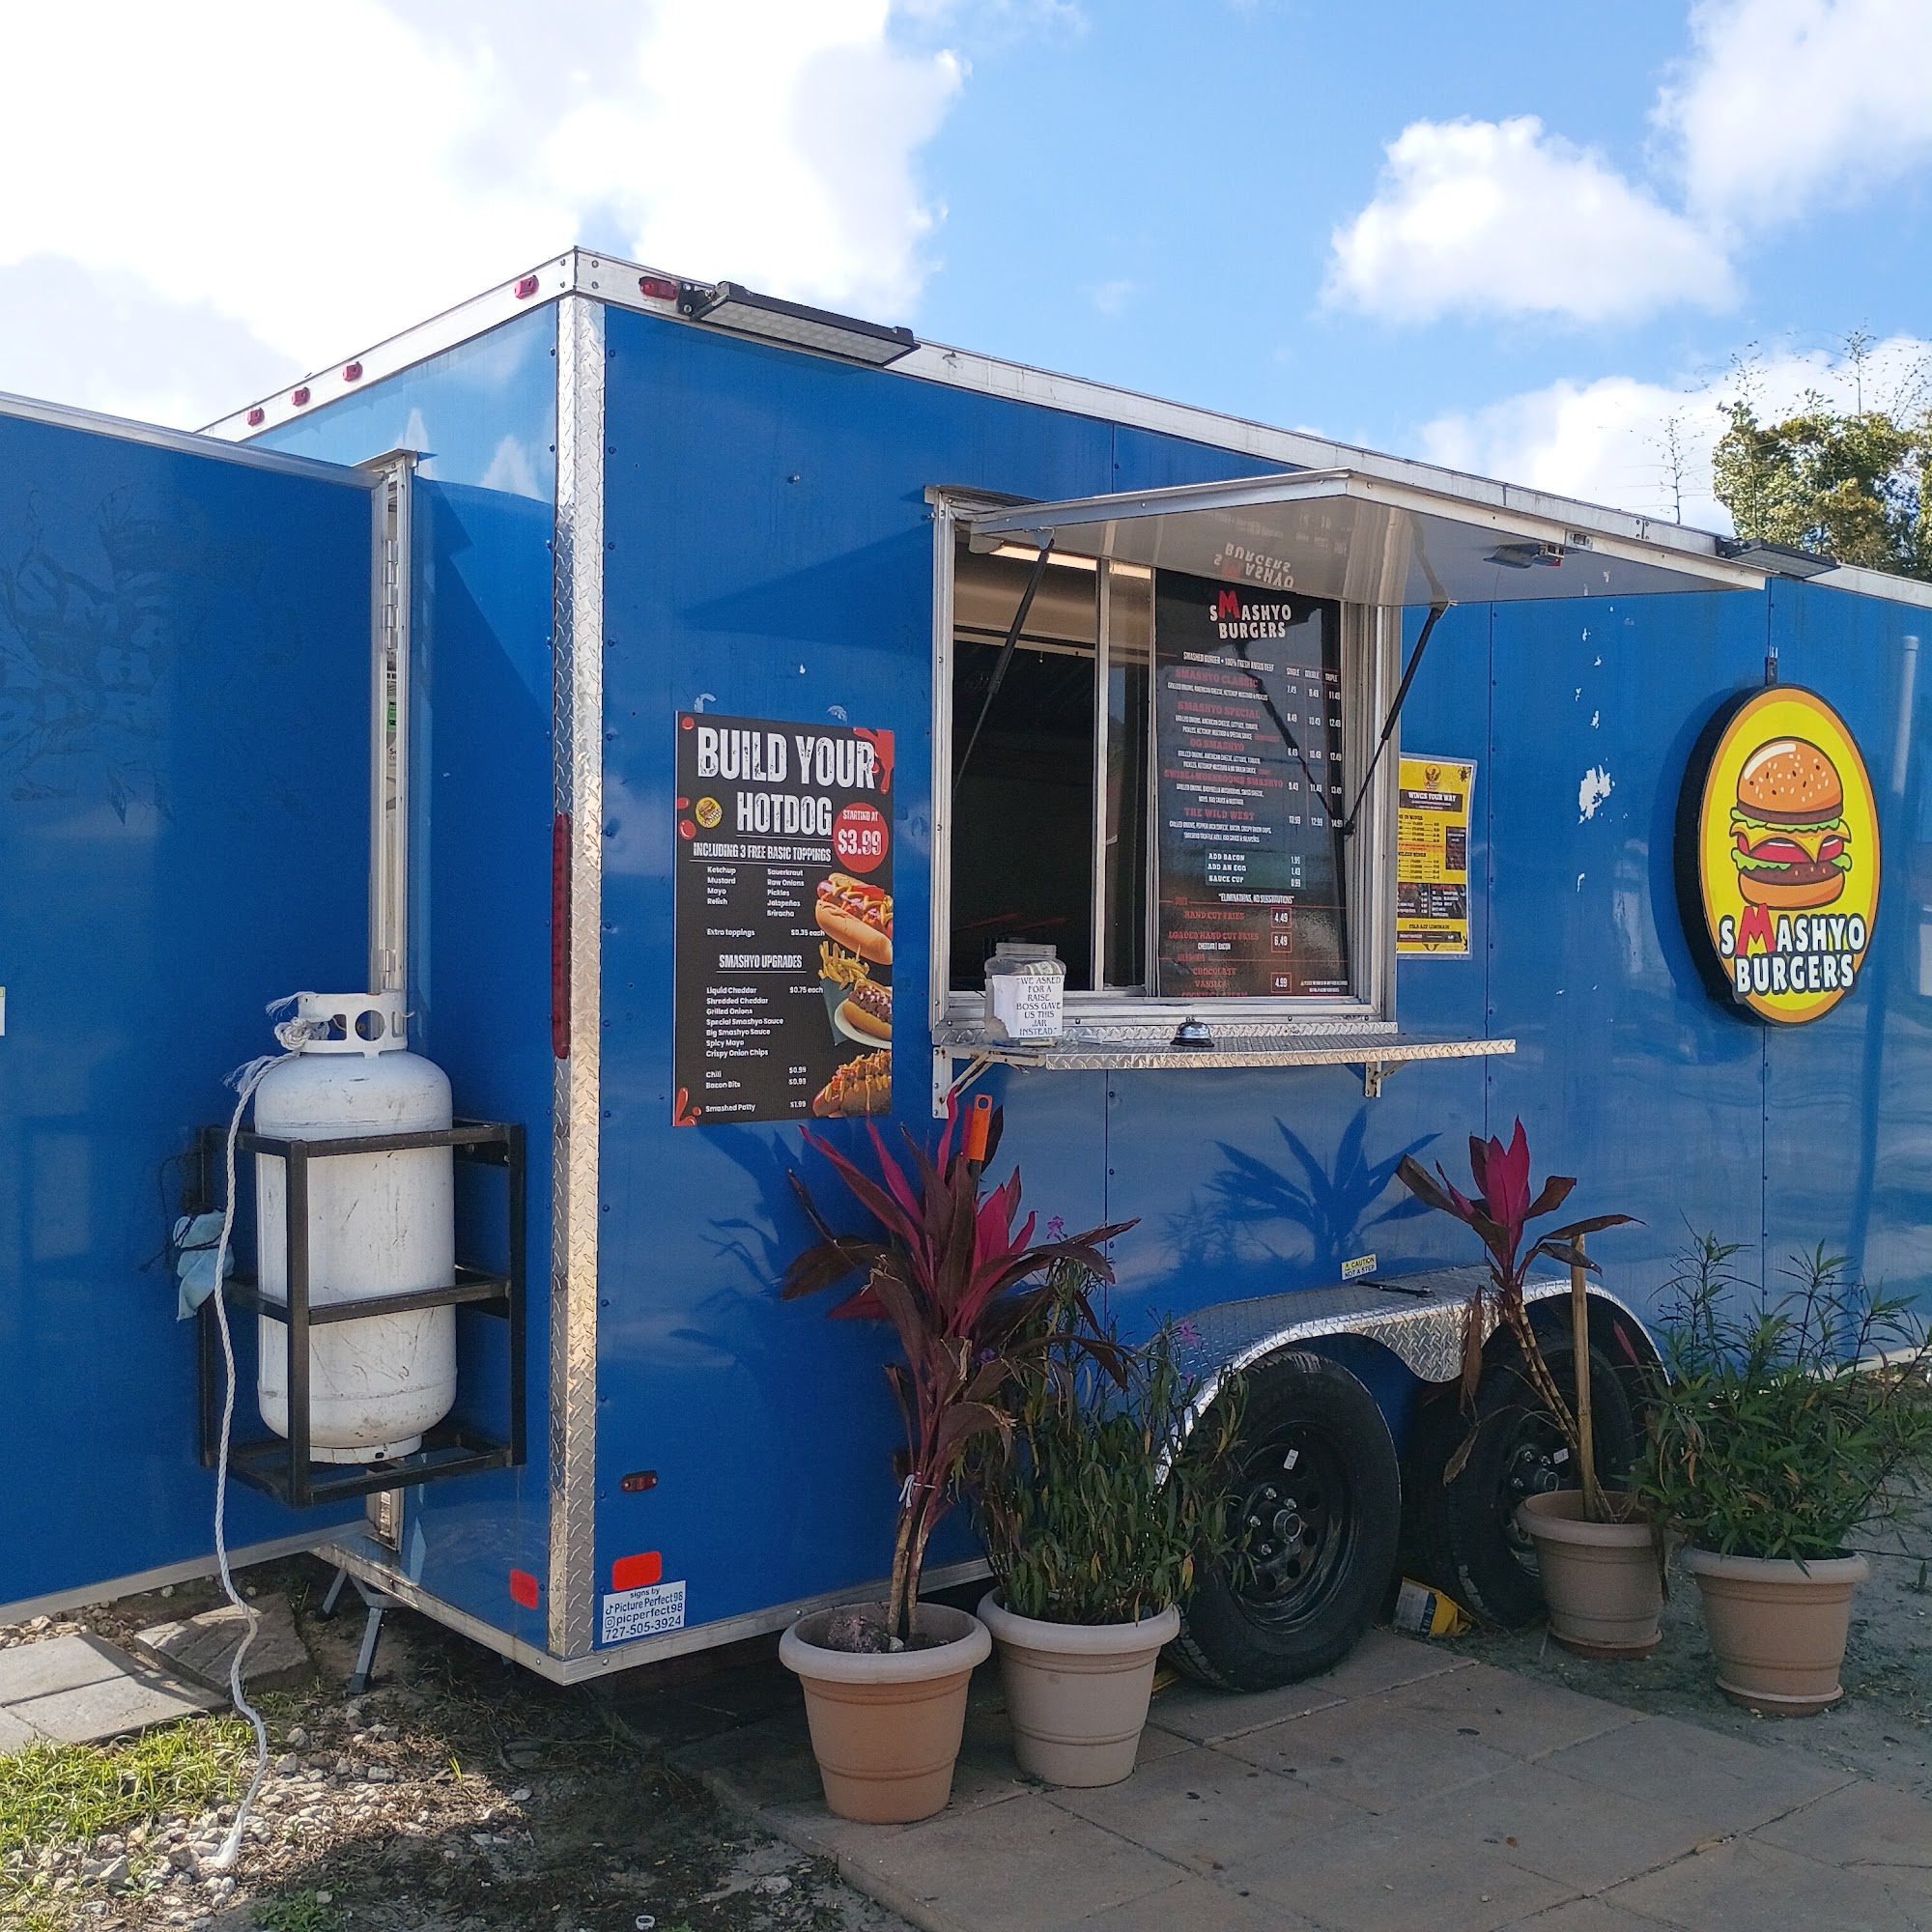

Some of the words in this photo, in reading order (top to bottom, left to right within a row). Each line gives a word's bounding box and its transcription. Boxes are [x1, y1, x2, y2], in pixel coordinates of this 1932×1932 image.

[1209, 589, 1292, 622] SMASHYO
[1219, 622, 1286, 639] BURGERS
[1175, 668, 1220, 682] SMASHYO
[1221, 674, 1258, 689] CLASSIC
[1178, 701, 1222, 714] SMASHYO
[1224, 706, 1260, 719] SPECIAL
[1204, 739, 1244, 752] SMASHYO
[697, 726, 787, 782] BUILD
[795, 736, 875, 789] YOUR
[736, 791, 833, 836] HOTDOG
[842, 809, 870, 821] STARTING
[871, 810, 879, 822] AT
[1184, 807, 1202, 817] THE
[1205, 809, 1227, 819] WILD
[1229, 810, 1254, 821] WEST
[838, 829, 881, 856] $3.99
[693, 842, 739, 858] INCLUDING
[740, 845, 746, 858] 3
[747, 845, 766, 859] FREE
[767, 846, 792, 861] BASIC
[792, 847, 832, 863] TOPPINGS
[1223, 853, 1245, 861] BACON
[707, 867, 736, 875] Ketchup
[767, 868, 803, 877] Sauerkraut
[1233, 864, 1247, 872] EGG
[707, 876, 736, 885] Mustard
[1208, 875, 1230, 883] SAUCE
[707, 887, 727, 896] Mayo
[707, 897, 728, 906] Relish
[767, 899, 801, 909] Jalapeños
[767, 909, 795, 918] Sriracha
[1275, 913, 1288, 923] 4.49
[725, 929, 755, 938] toppings
[1719, 903, 1866, 957] SMASHYO
[1274, 936, 1288, 946] 6.49
[719, 955, 760, 968] SMASHYO
[761, 955, 802, 968] UPGRADES
[1735, 953, 1855, 994] BURGERS
[1275, 978, 1288, 987] 4.99
[707, 987, 727, 995] Liquid
[706, 1018, 731, 1026] Special
[732, 1018, 763, 1026] Smashyo
[706, 1029, 717, 1037] Big
[718, 1028, 749, 1037] Smashyo
[706, 1039, 724, 1048] Spicy
[725, 1039, 744, 1048] Mayo
[706, 1050, 728, 1059] Crispy
[750, 1050, 768, 1058] Chips
[737, 1103, 756, 1112] Patty
[1351, 1257, 1375, 1268] CAUTION
[1345, 1270, 1356, 1278] NOT
[1362, 1264, 1375, 1274] STEP
[630, 1589, 650, 1598] signs
[615, 1601, 643, 1613] Picture
[617, 1603, 682, 1626] picperfect98
[605, 1615, 681, 1640] 727-505-3924
